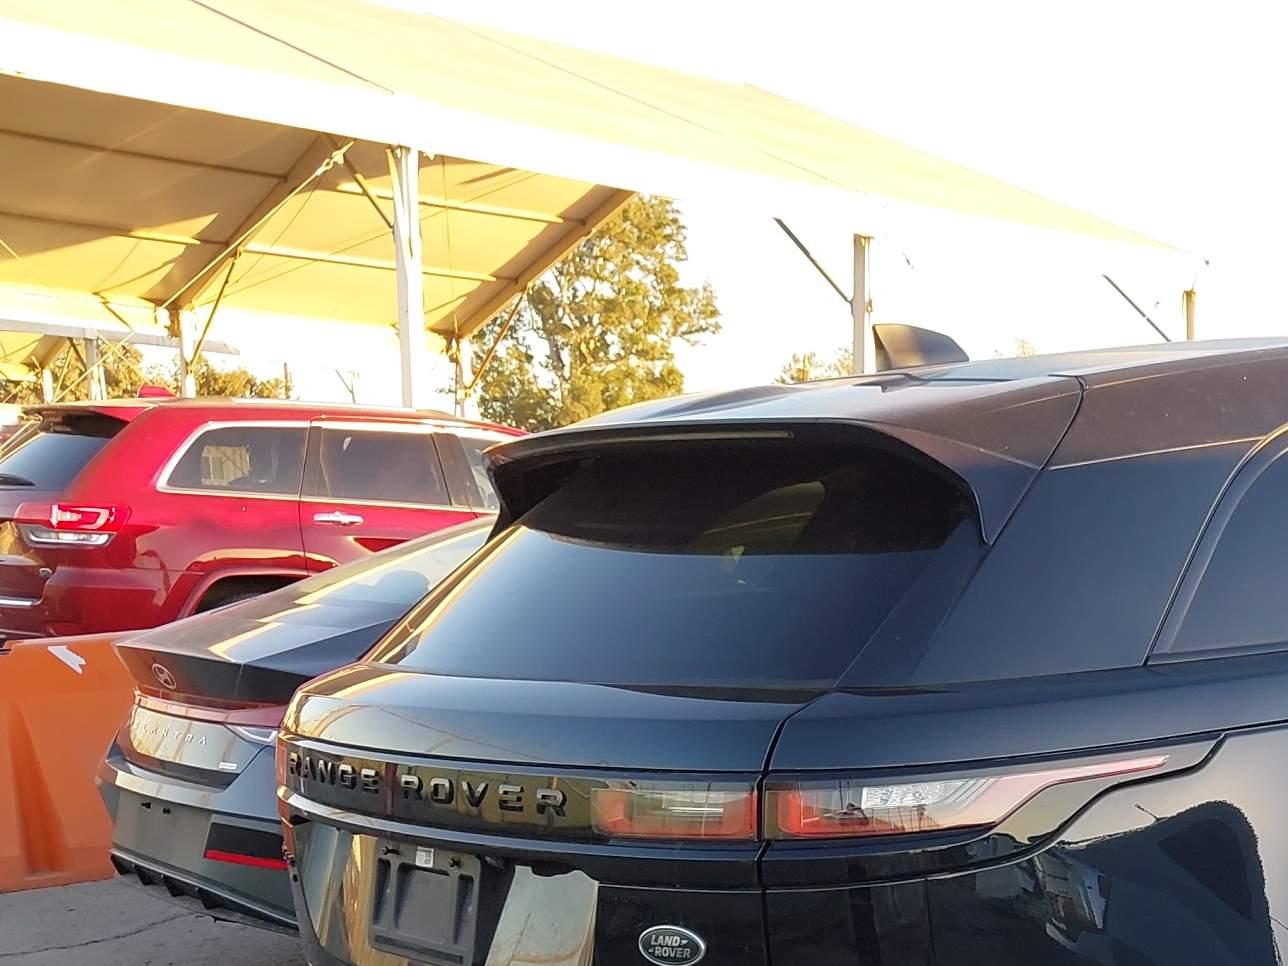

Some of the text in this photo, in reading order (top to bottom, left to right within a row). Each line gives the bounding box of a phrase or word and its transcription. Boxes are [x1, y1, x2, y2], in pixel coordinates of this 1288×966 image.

[135, 722, 208, 745] ELANTRA
[289, 752, 568, 817] RANGE ROVER
[650, 934, 681, 947] LAND
[654, 946, 692, 959] ROVER
